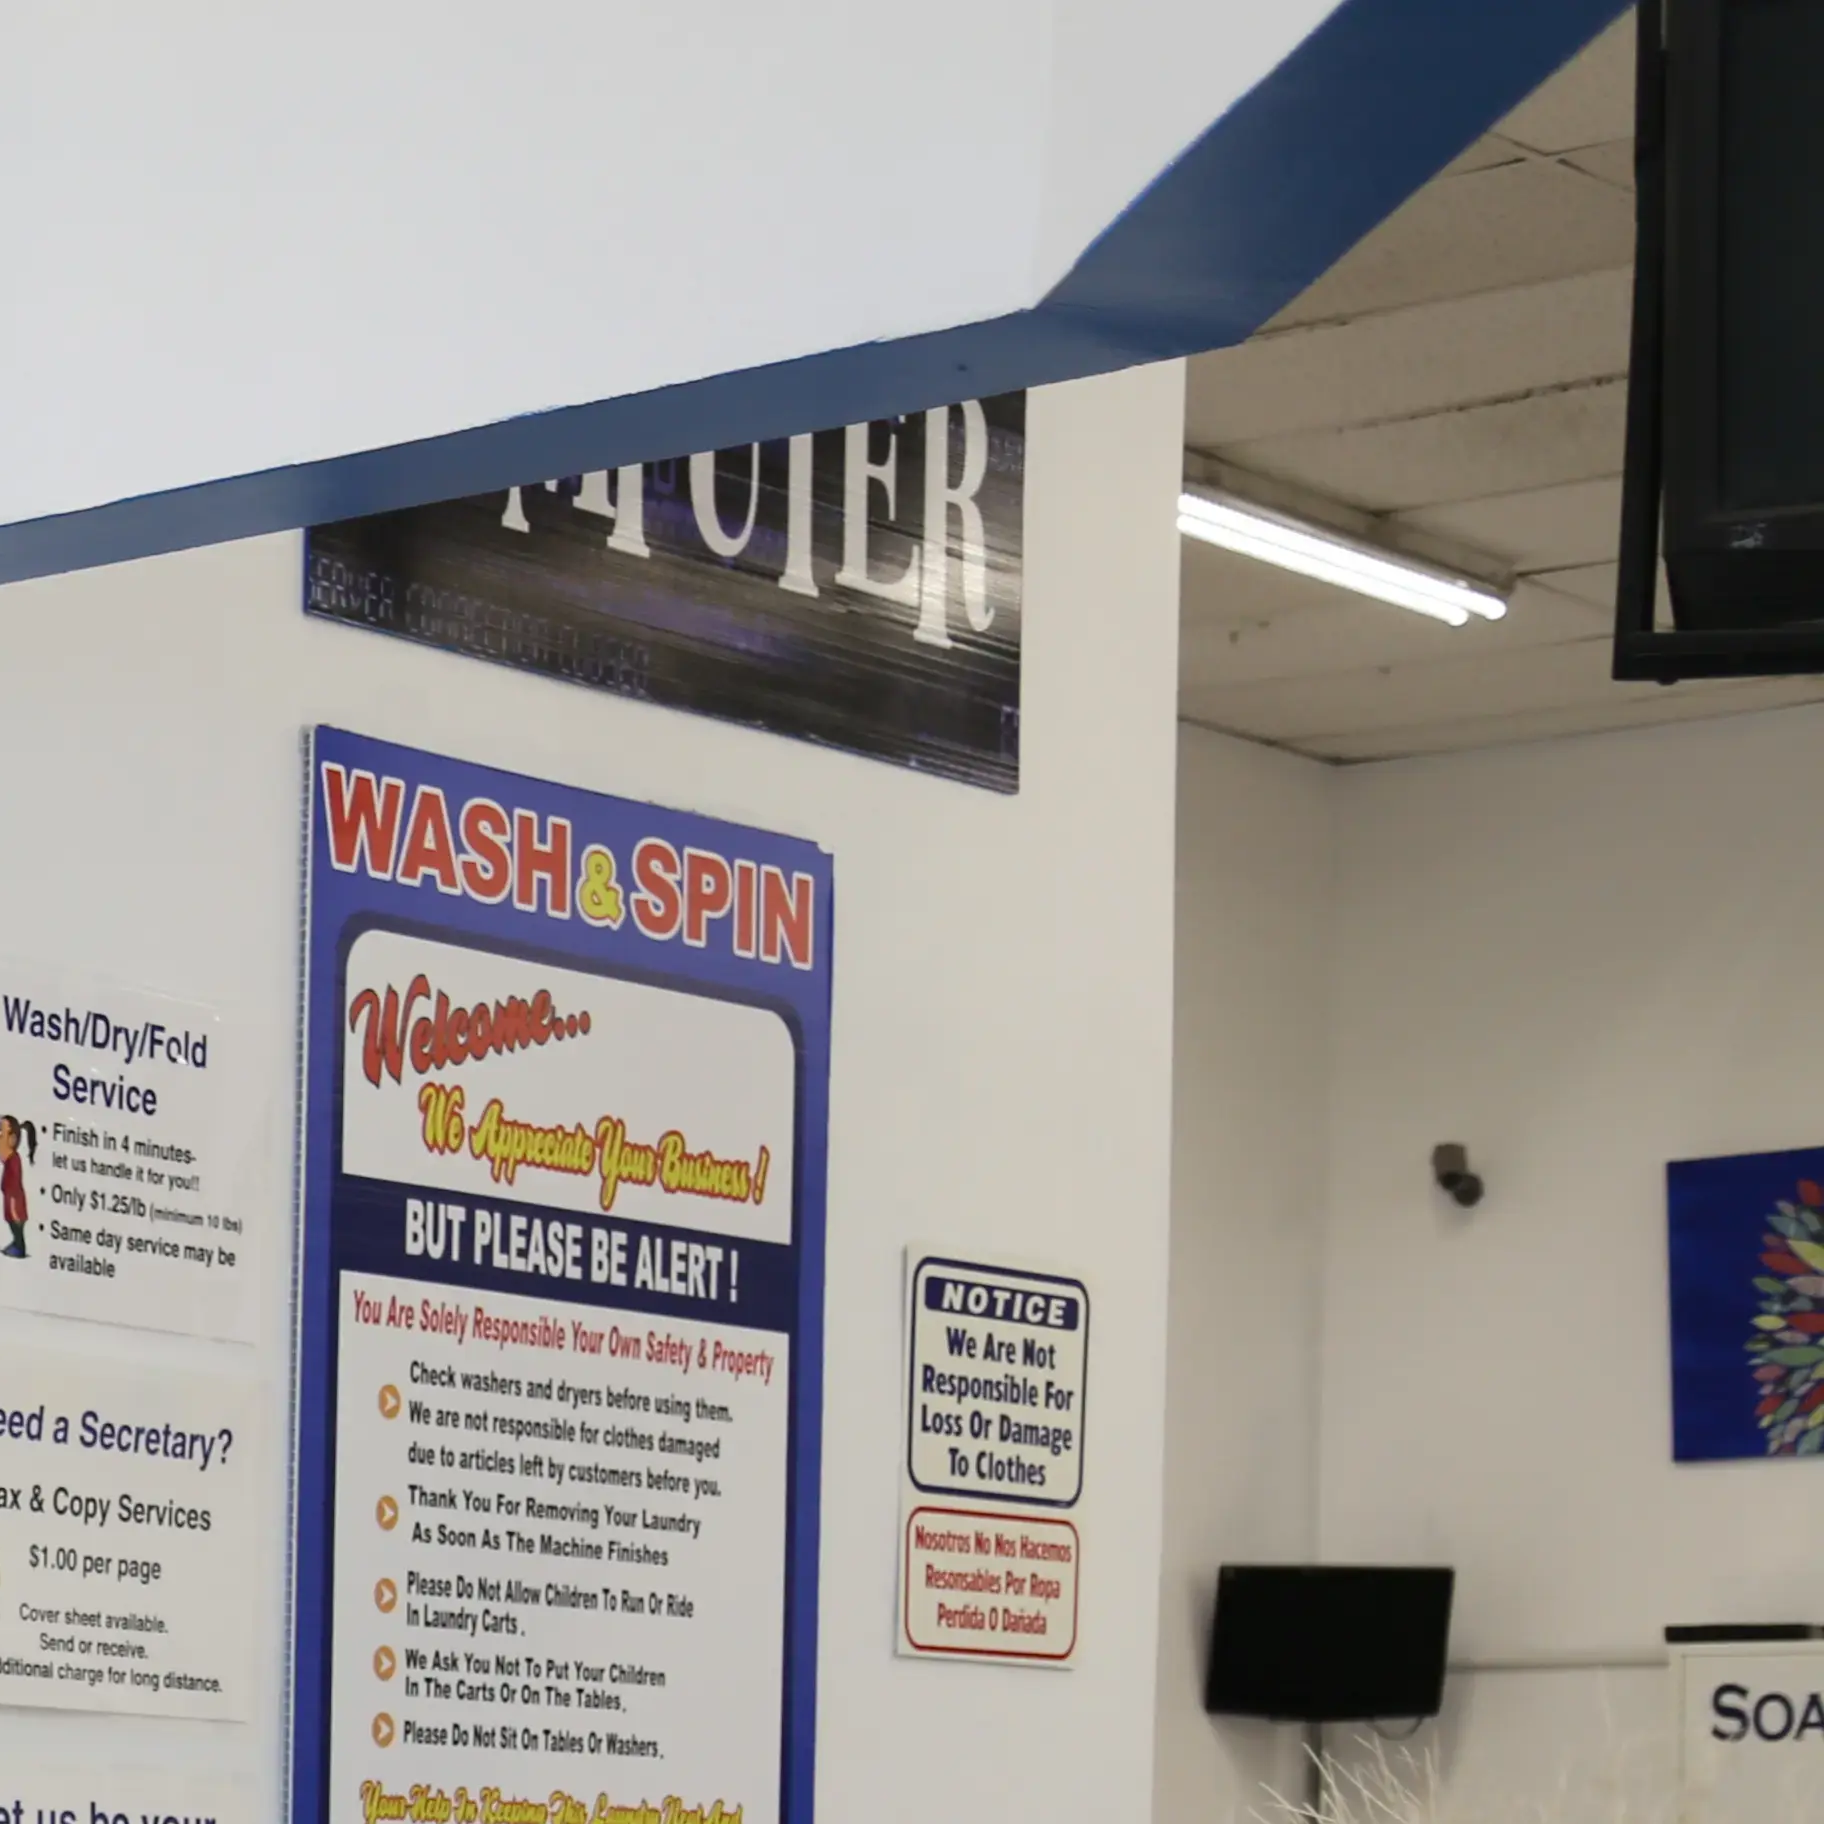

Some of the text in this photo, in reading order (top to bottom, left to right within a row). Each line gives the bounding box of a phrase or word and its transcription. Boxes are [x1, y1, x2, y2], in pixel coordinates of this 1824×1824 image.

[322, 762, 814, 969] WASH & SPIN
[2, 994, 208, 1069] Wash/Dry/Fold
[52, 1063, 157, 1116] Service
[53, 1122, 99, 1147] Finish
[103, 1129, 117, 1151] in
[121, 1130, 130, 1151] 4
[419, 1082, 465, 1153] We
[469, 1099, 593, 1185] Appreciate
[595, 1116, 658, 1210] Your
[405, 1198, 466, 1262] BUT
[474, 1210, 582, 1280] PLEASE
[591, 1221, 627, 1286] BE
[941, 1282, 1067, 1327] NOTICE
[354, 1291, 774, 1385] You Are Solely Responsible Your Own Safety & Property
[946, 1328, 1056, 1370] We Are Not
[410, 1361, 733, 1423] Check washers and dryers before using them.
[922, 1364, 1073, 1411] Responsible For
[53, 1416, 69, 1444] a
[80, 1410, 234, 1471] Secretary?
[921, 1404, 1072, 1455] Loss Or Damage
[948, 1448, 1046, 1487] To Clothes
[29, 1485, 45, 1514] &
[52, 1487, 110, 1527] Copy
[117, 1494, 211, 1531] Services
[29, 1544, 161, 1584] $1.00 per page
[915, 1525, 1071, 1562] Nosotros No Nos Hacemos
